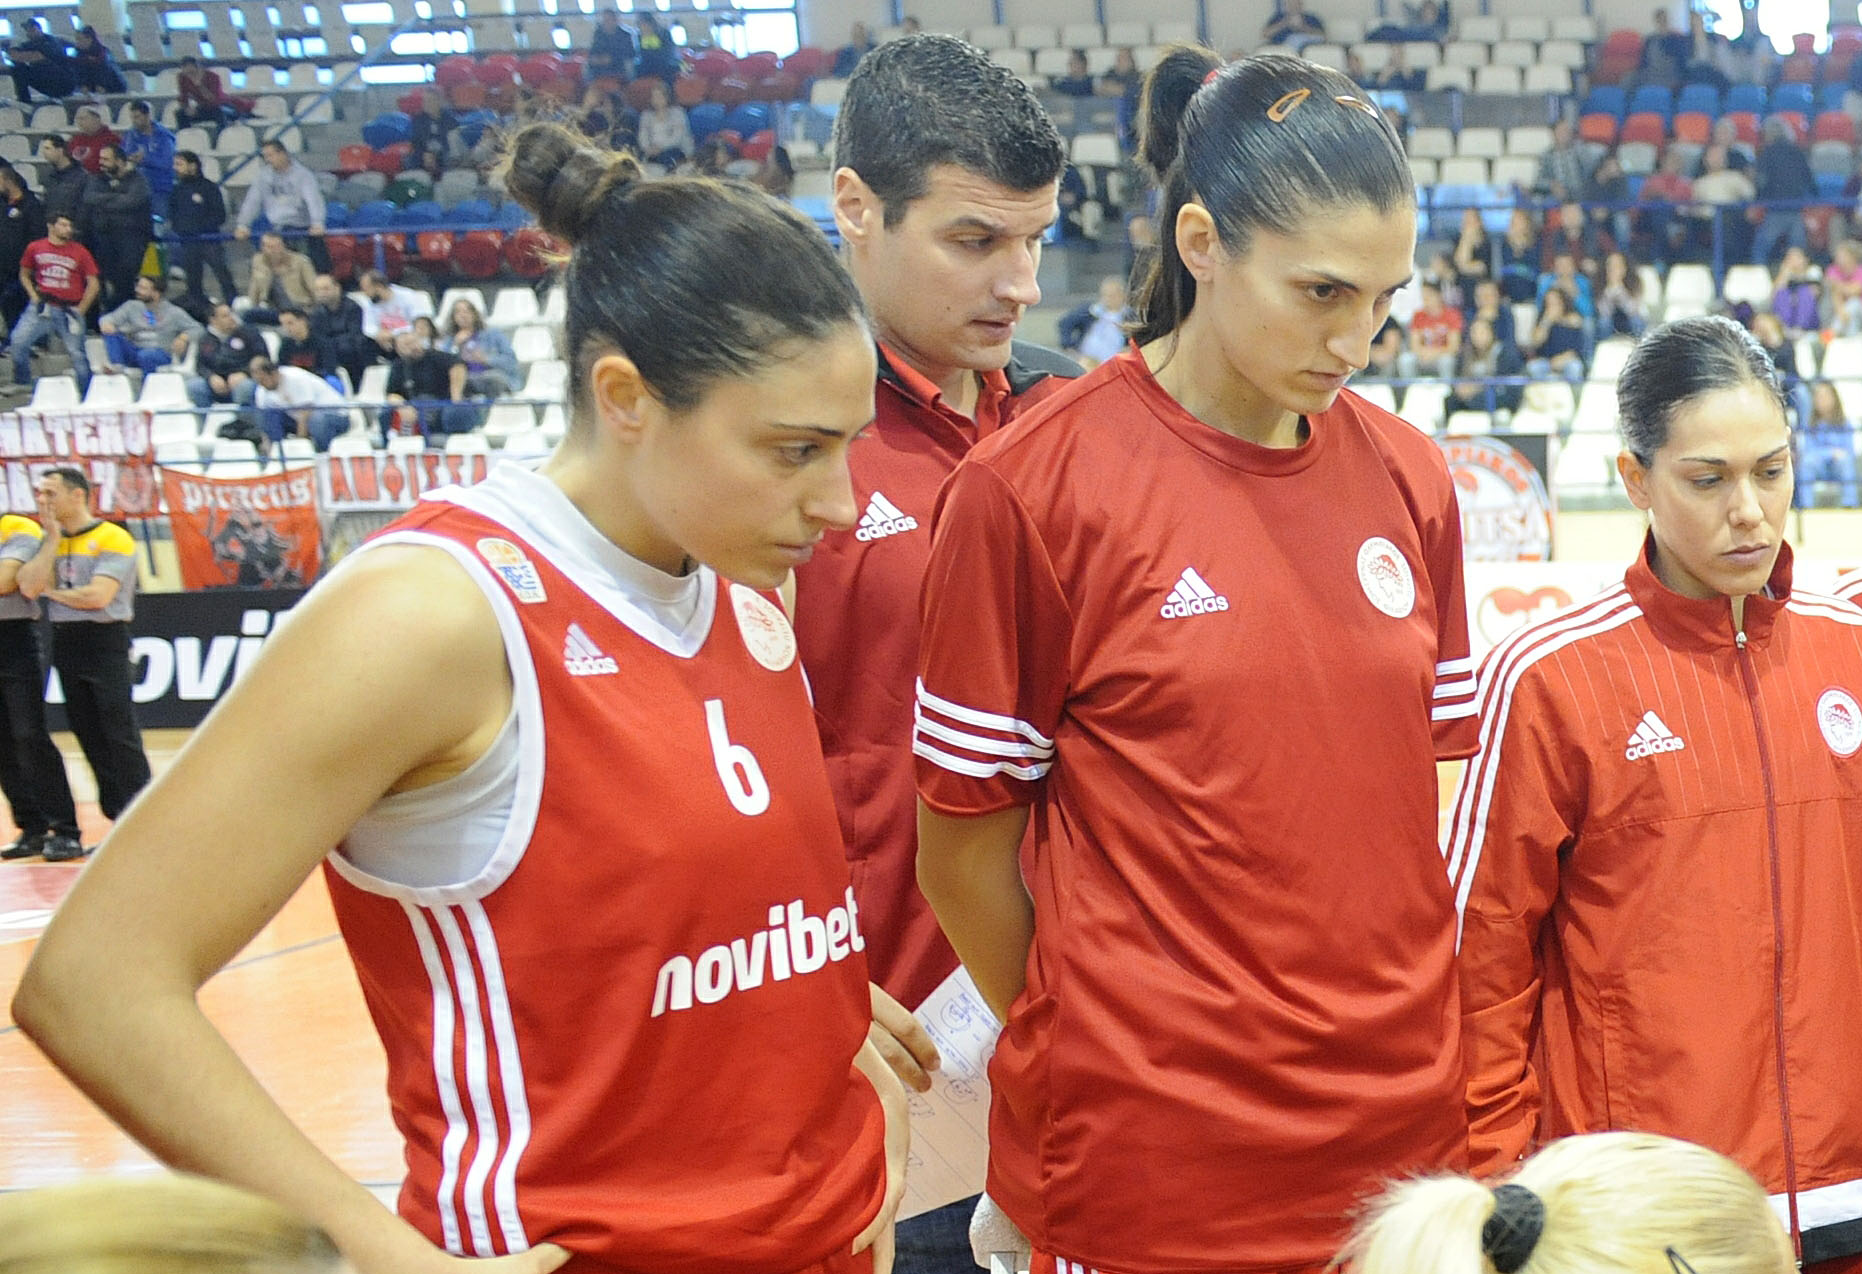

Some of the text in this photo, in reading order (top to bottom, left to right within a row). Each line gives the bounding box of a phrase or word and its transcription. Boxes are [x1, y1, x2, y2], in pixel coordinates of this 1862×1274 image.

[855, 515, 918, 541] adidas
[1160, 594, 1229, 619] adidas
[704, 698, 770, 816] 6
[1626, 735, 1684, 761] adidas
[651, 885, 866, 1018] novibet
